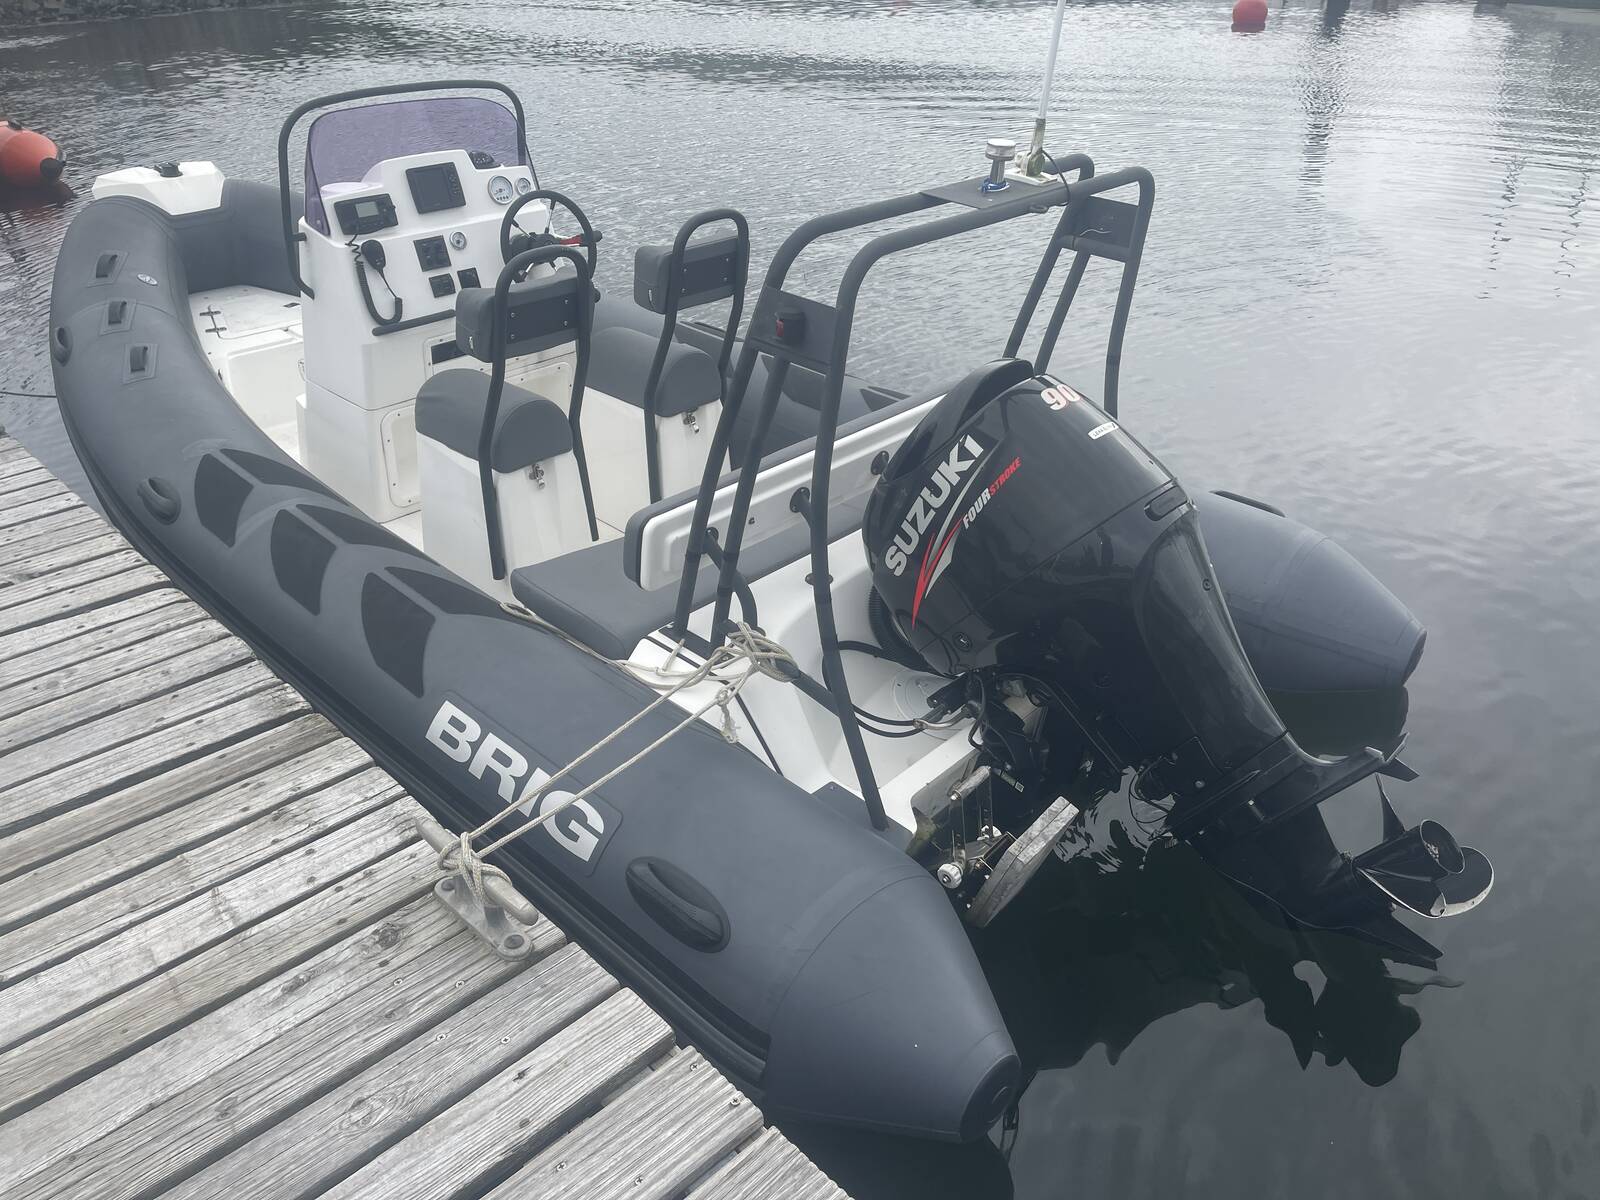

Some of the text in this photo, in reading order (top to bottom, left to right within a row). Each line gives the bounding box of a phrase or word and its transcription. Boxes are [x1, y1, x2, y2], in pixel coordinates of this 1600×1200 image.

[1040, 384, 1082, 411] 90
[885, 434, 984, 577] SUZUKI
[425, 700, 605, 862] BRIG
